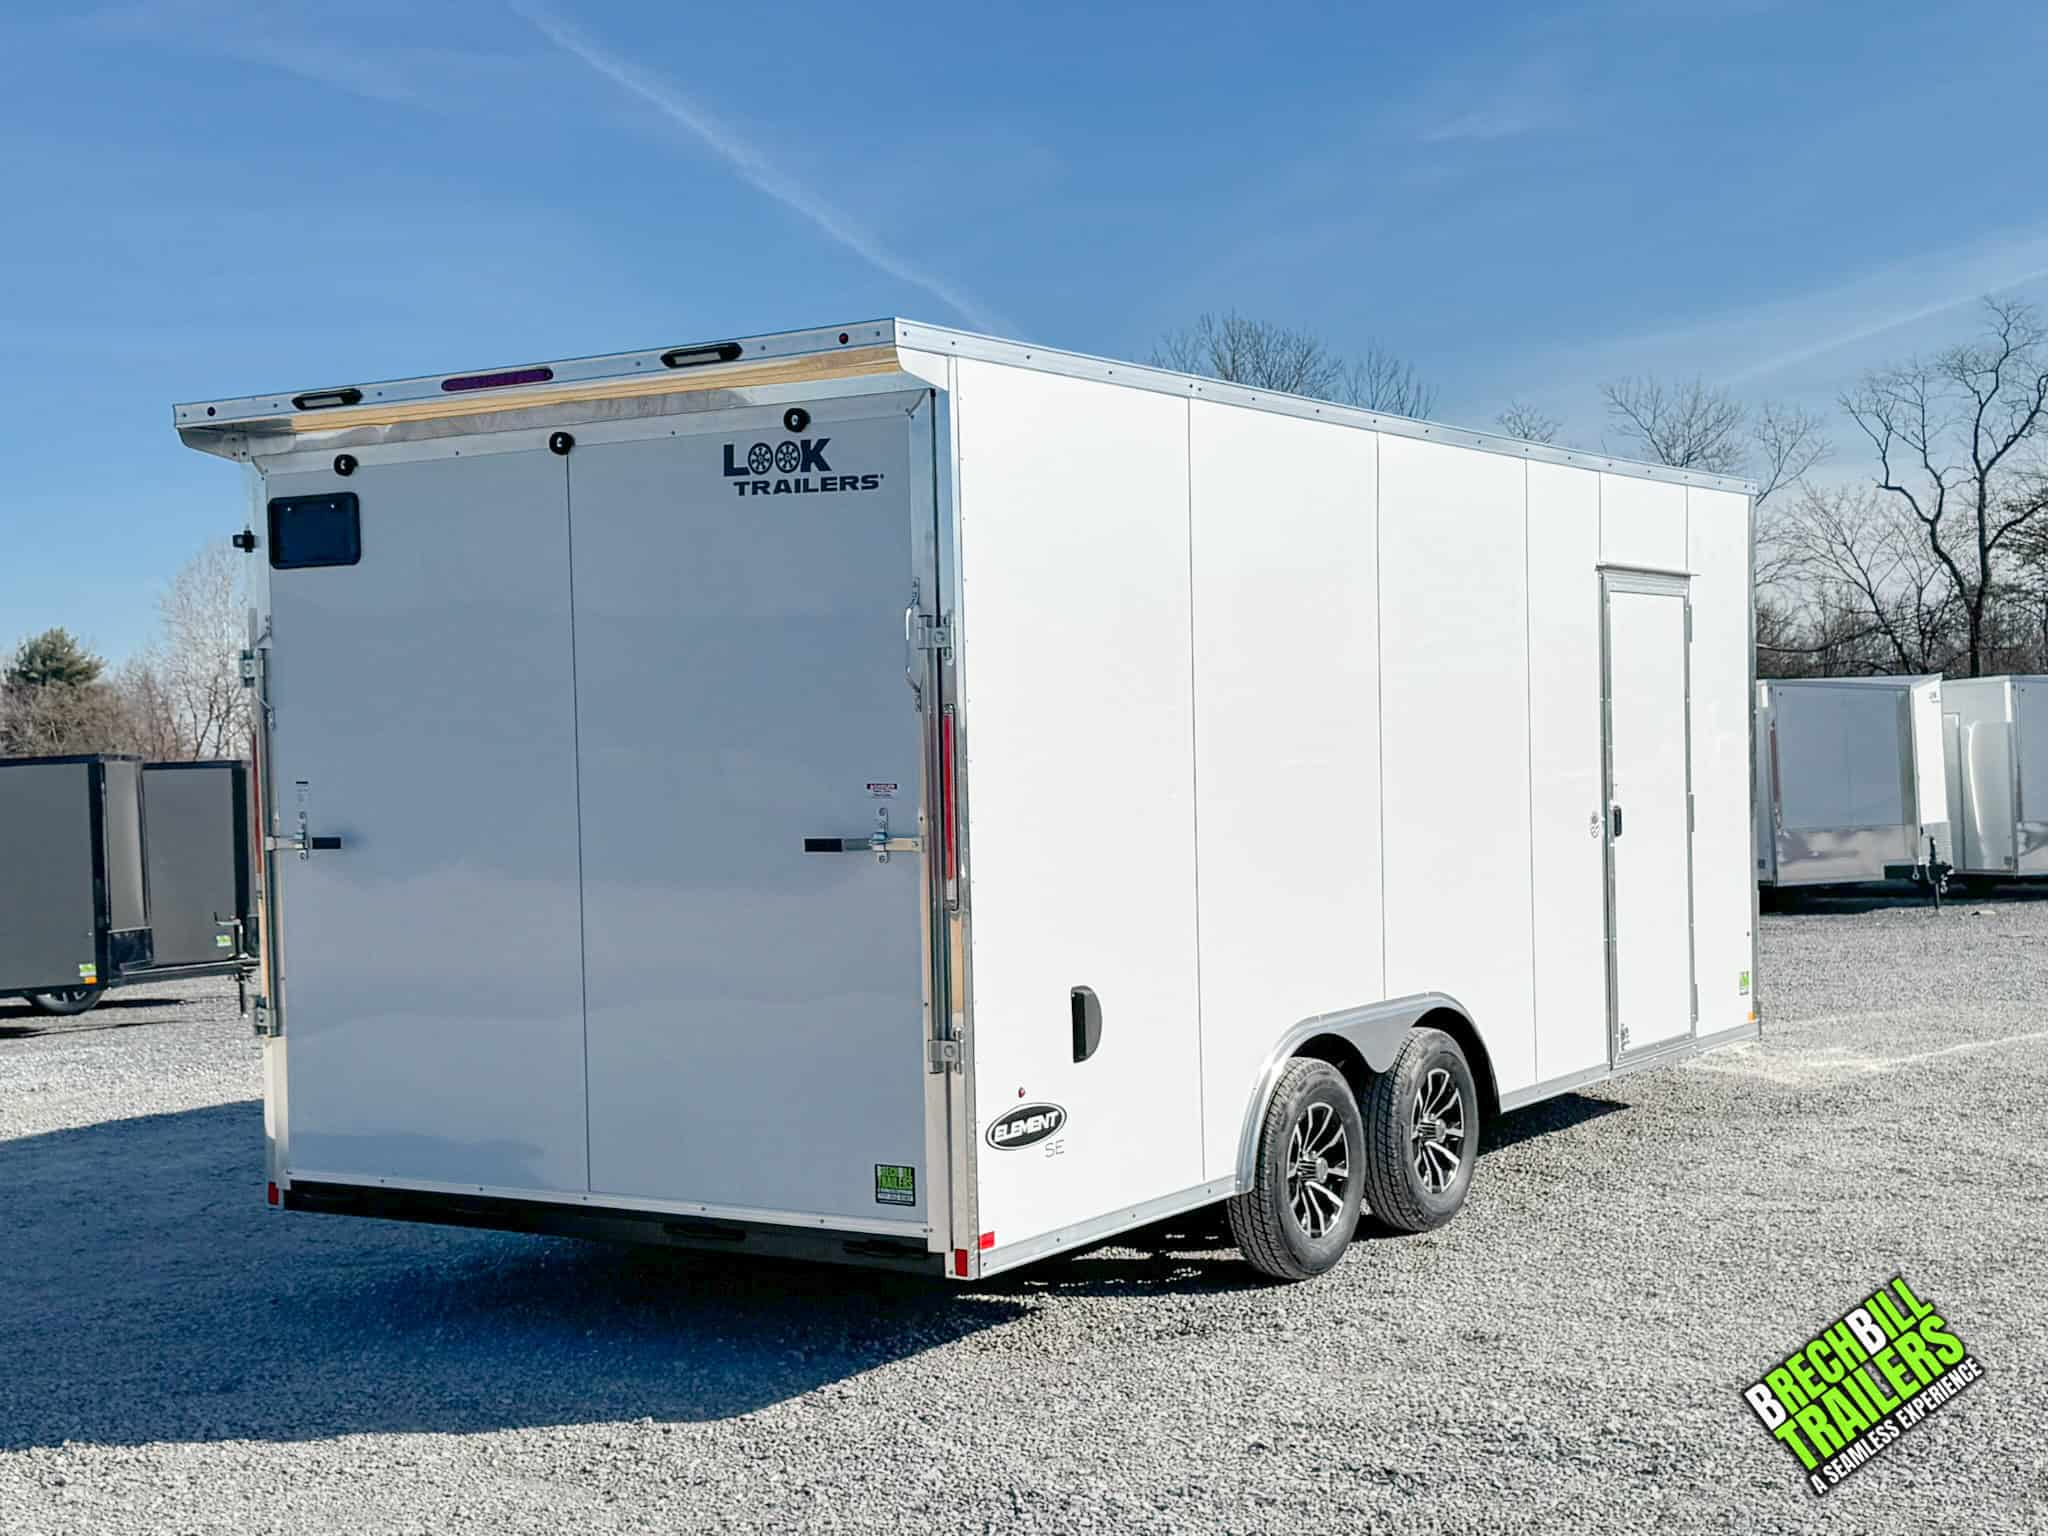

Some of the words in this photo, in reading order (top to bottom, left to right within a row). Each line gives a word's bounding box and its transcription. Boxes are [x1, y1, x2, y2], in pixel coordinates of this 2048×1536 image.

[723, 438, 832, 477] LOOK
[733, 474, 880, 496] TRAILERS
[993, 1110, 1060, 1143] ELEMENT
[1045, 1139, 1064, 1158] SE
